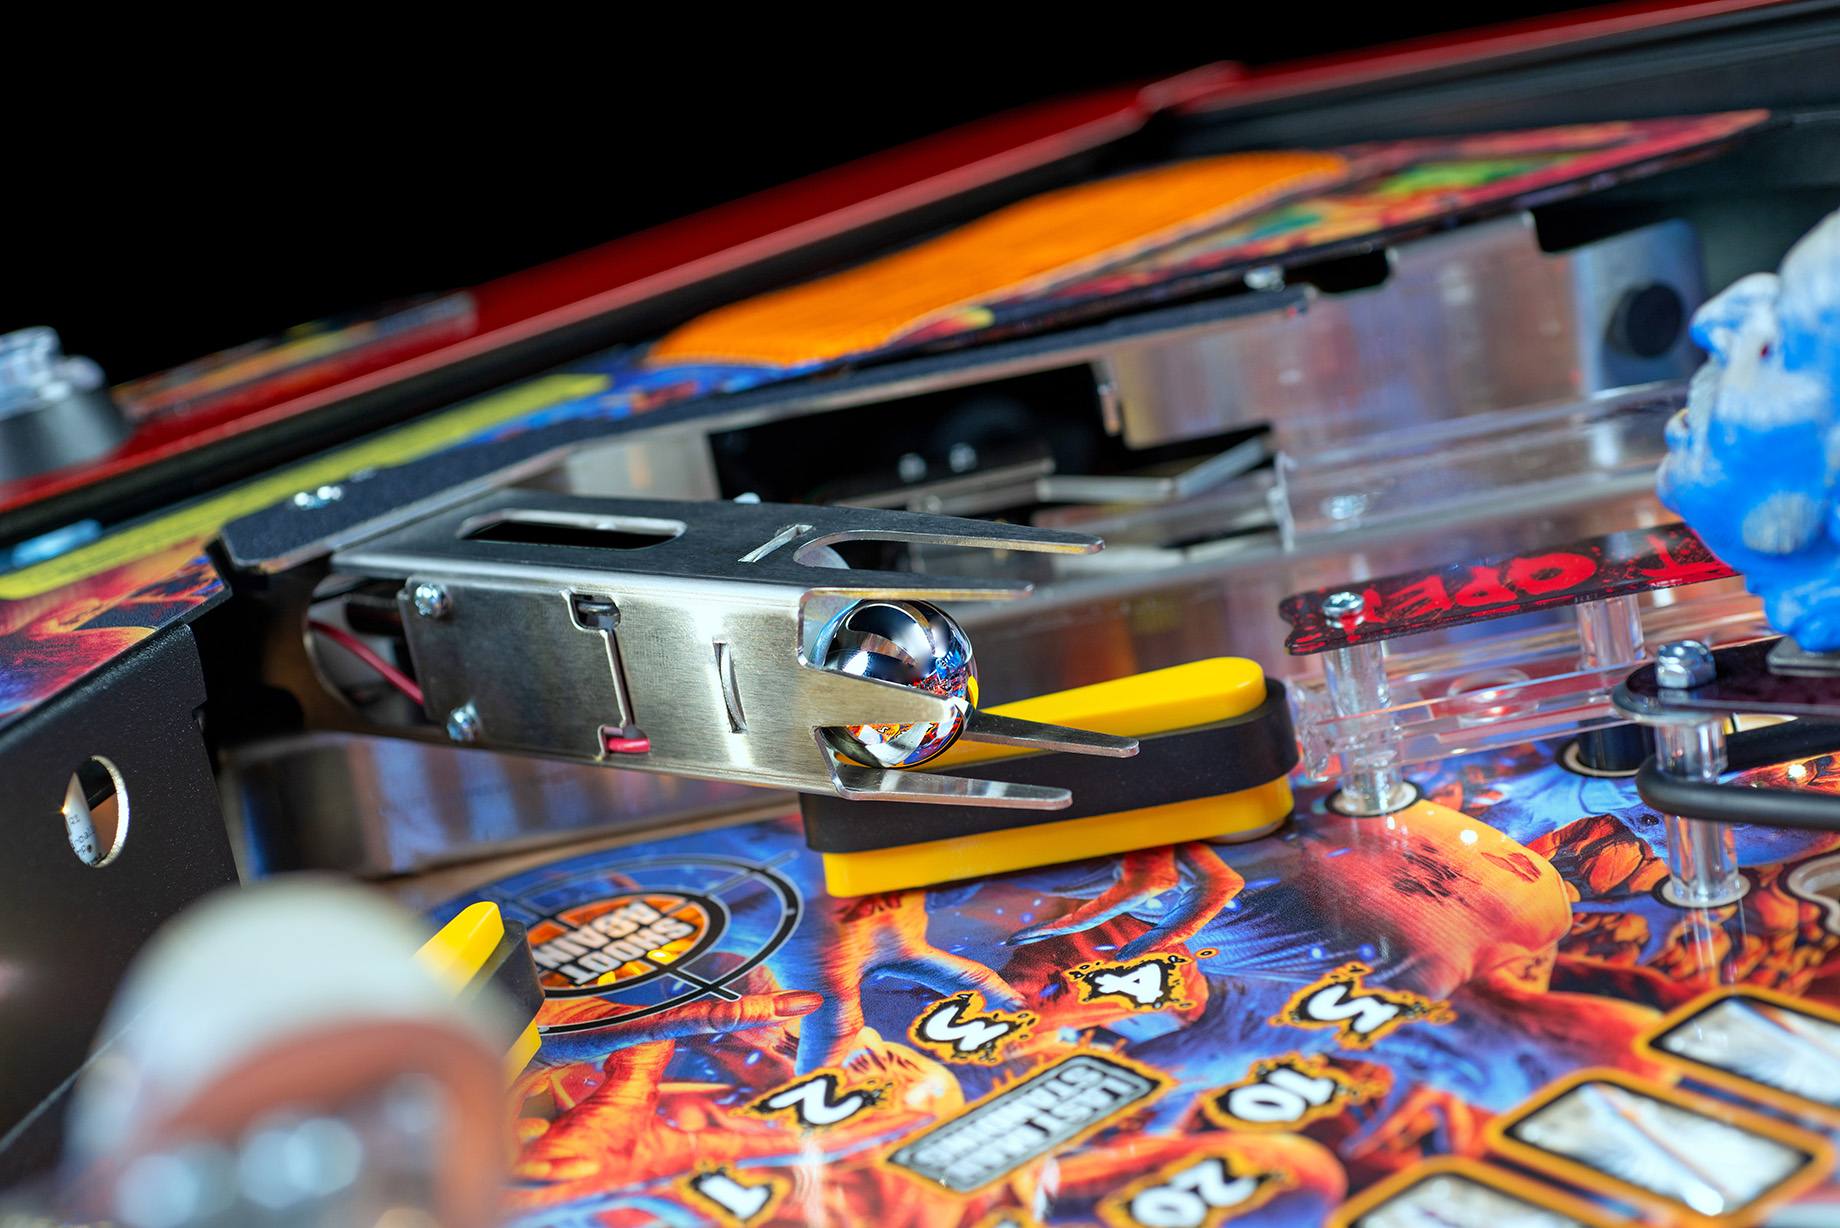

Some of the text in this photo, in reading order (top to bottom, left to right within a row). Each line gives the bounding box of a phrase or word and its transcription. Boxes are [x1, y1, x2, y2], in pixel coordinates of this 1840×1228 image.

[534, 900, 662, 969] AGAIN
[561, 917, 697, 985] SHOOT
[1094, 963, 1164, 1003] 4
[1307, 985, 1399, 1034] 5
[925, 1005, 1009, 1051] 3
[768, 1078, 864, 1125] 2
[912, 1065, 1105, 1165] STANDING
[1030, 1076, 1137, 1134] LAST
[1229, 1068, 1336, 1122] 10
[700, 1174, 770, 1219] 1
[1131, 1159, 1258, 1228] 20
